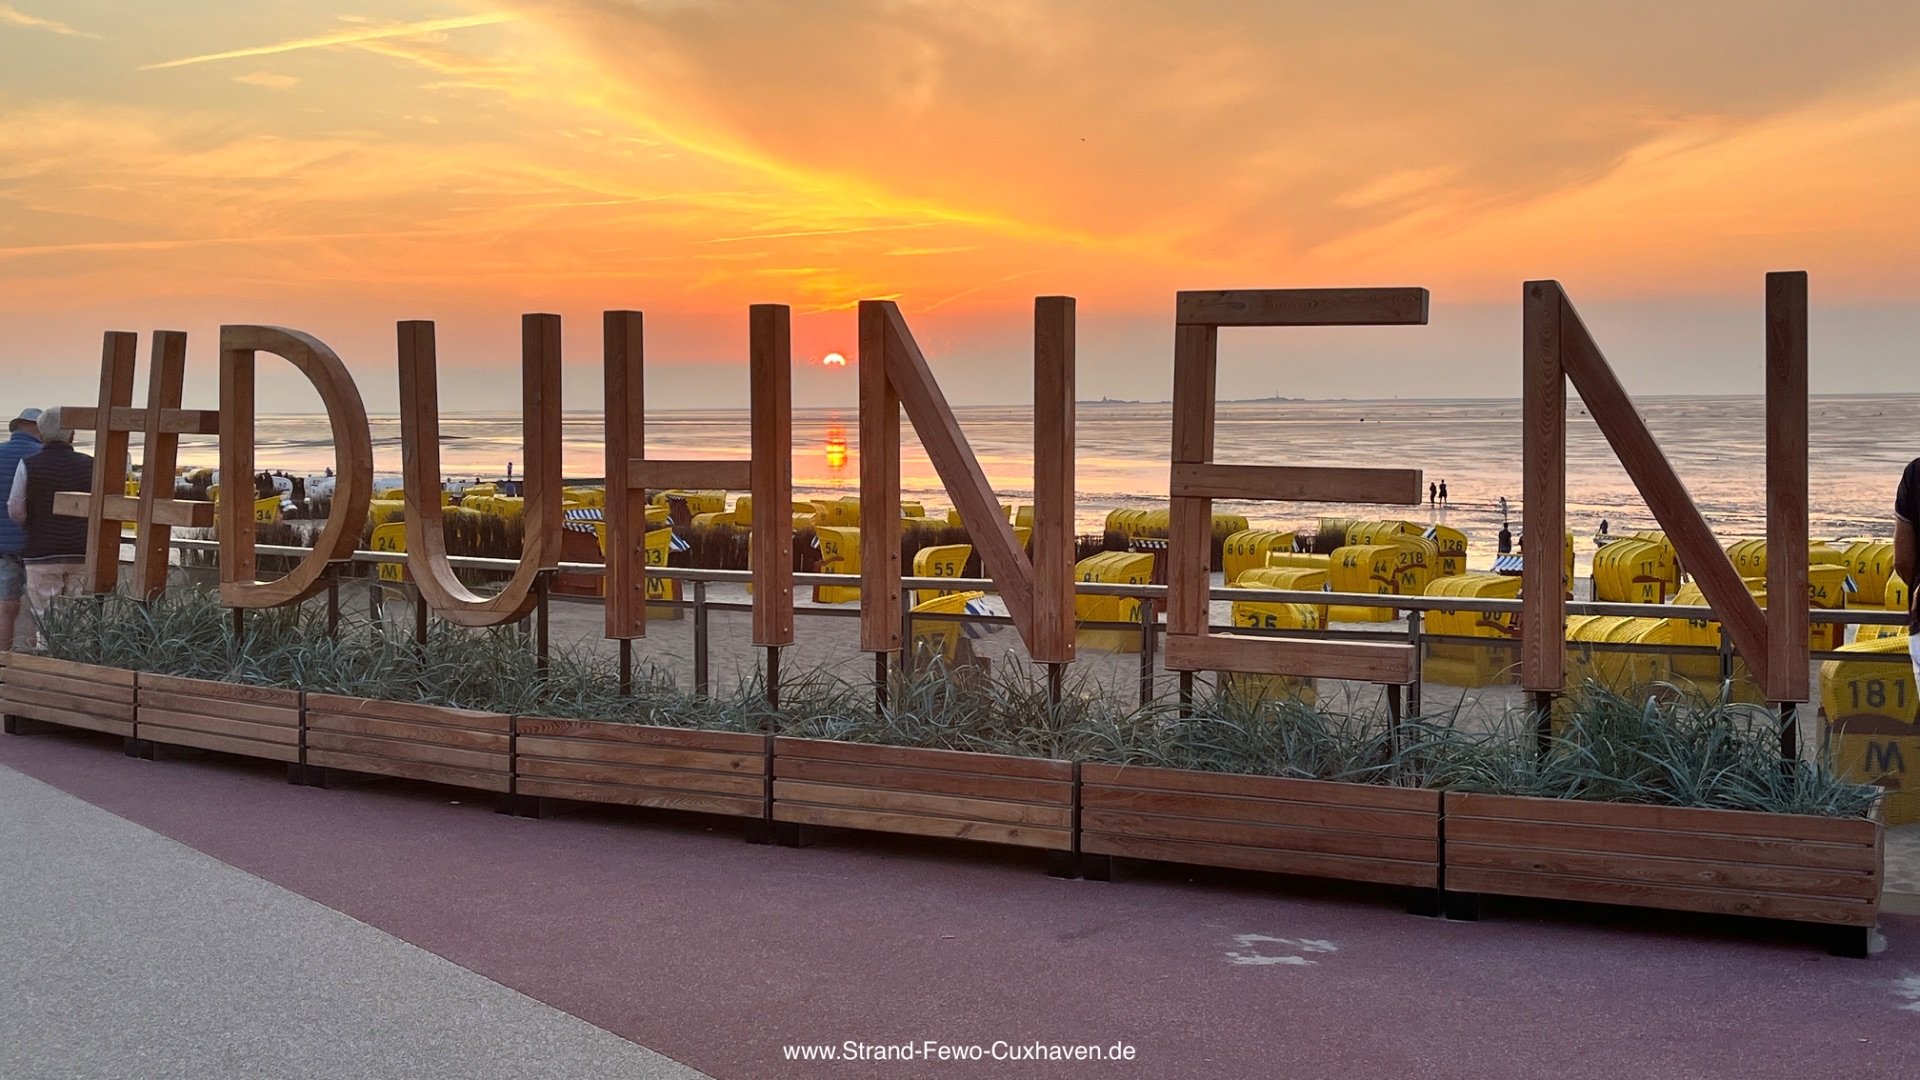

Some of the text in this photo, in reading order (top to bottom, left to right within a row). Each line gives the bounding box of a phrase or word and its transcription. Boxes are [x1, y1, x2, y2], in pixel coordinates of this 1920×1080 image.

[52, 271, 1808, 702] #DUHNEN
[379, 537, 396, 550] 24
[825, 542, 838, 555] 54
[1444, 539, 1463, 551] 126
[1343, 555, 1357, 568] 44
[1400, 552, 1424, 565] 218
[1444, 558, 1456, 570] M
[382, 565, 398, 578] M
[934, 562, 954, 576] 55
[1373, 560, 1387, 573] 44
[1641, 561, 1653, 575] 11
[1402, 572, 1417, 585] M
[1642, 584, 1653, 597] M
[1848, 679, 1905, 709] 181
[1865, 741, 1905, 773] M
